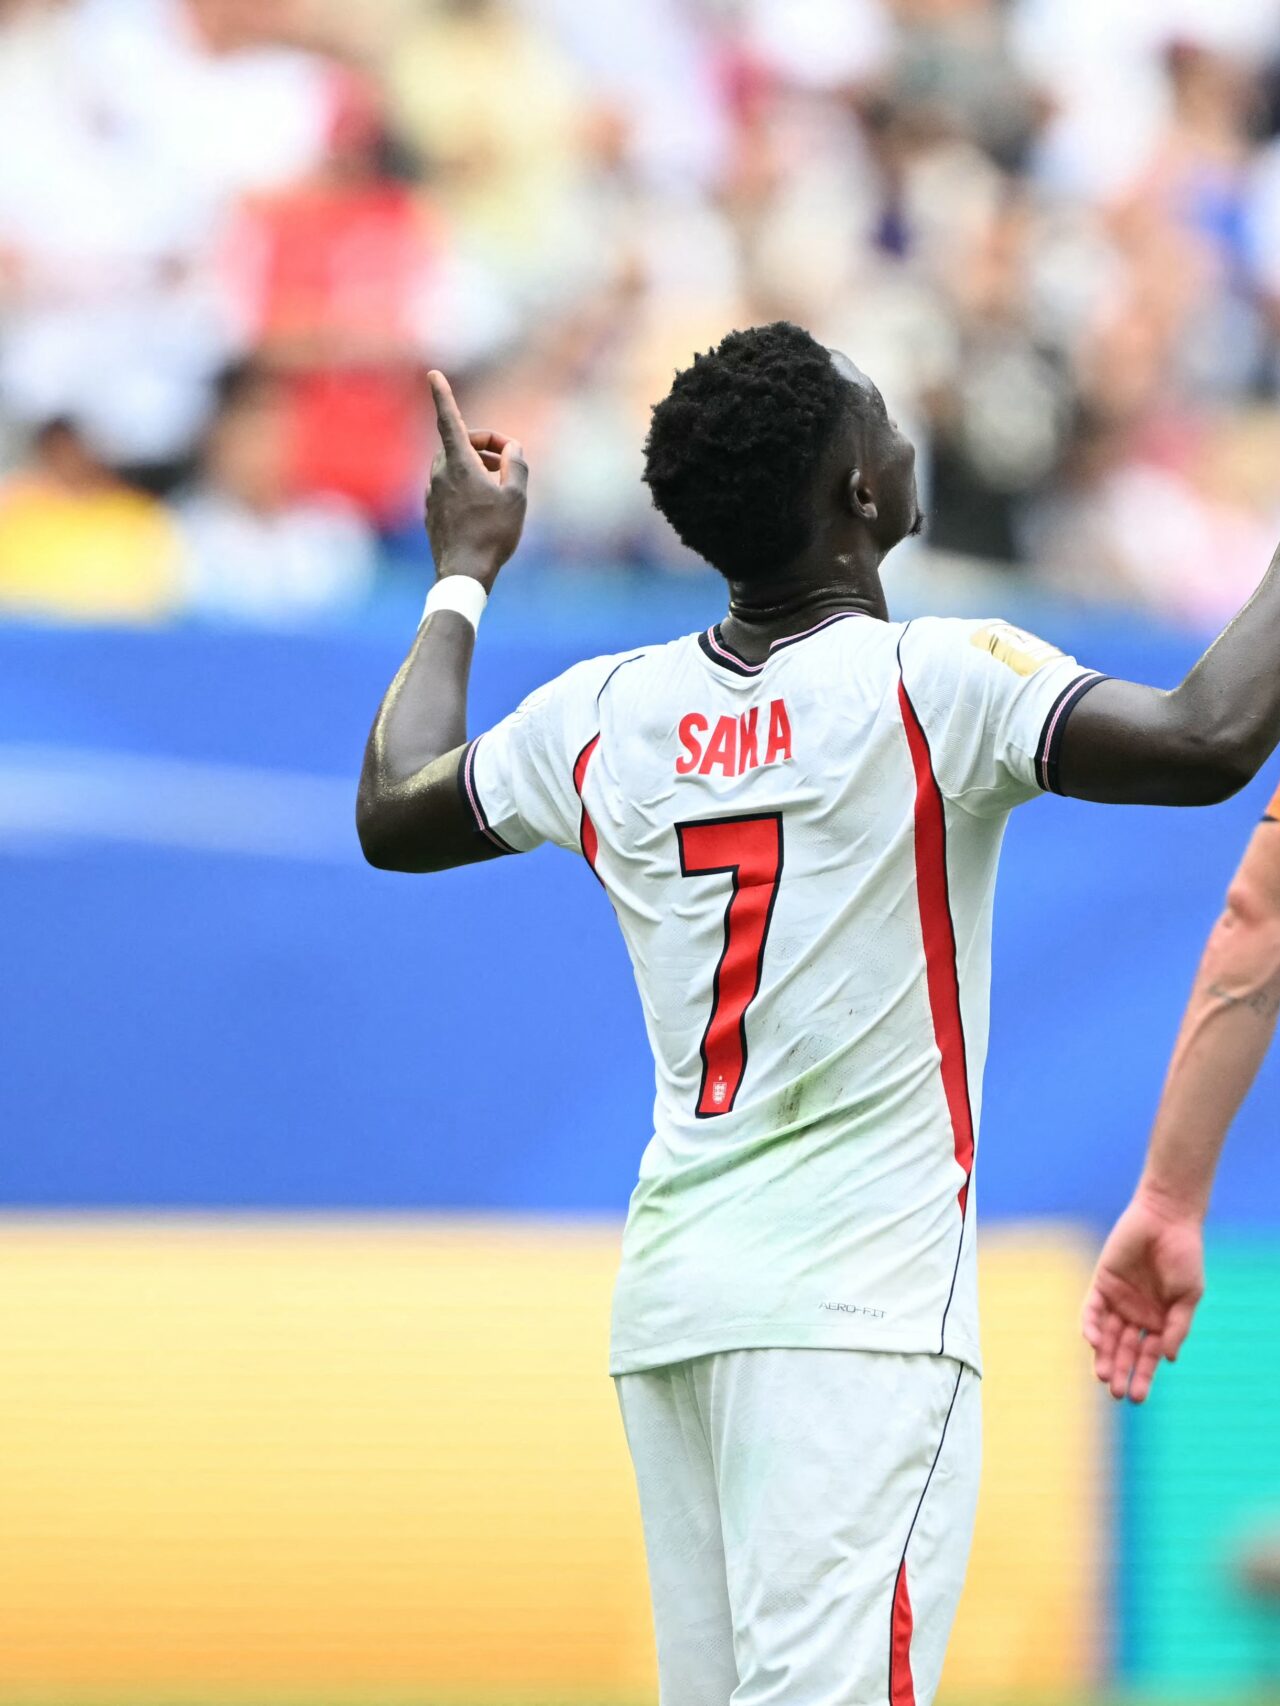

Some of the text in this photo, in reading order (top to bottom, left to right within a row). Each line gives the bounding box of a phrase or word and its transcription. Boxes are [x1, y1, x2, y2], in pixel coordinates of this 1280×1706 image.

[675, 698, 792, 777] SAKA
[674, 811, 784, 1118] 7
[818, 1301, 887, 1319] AERO-FIT
